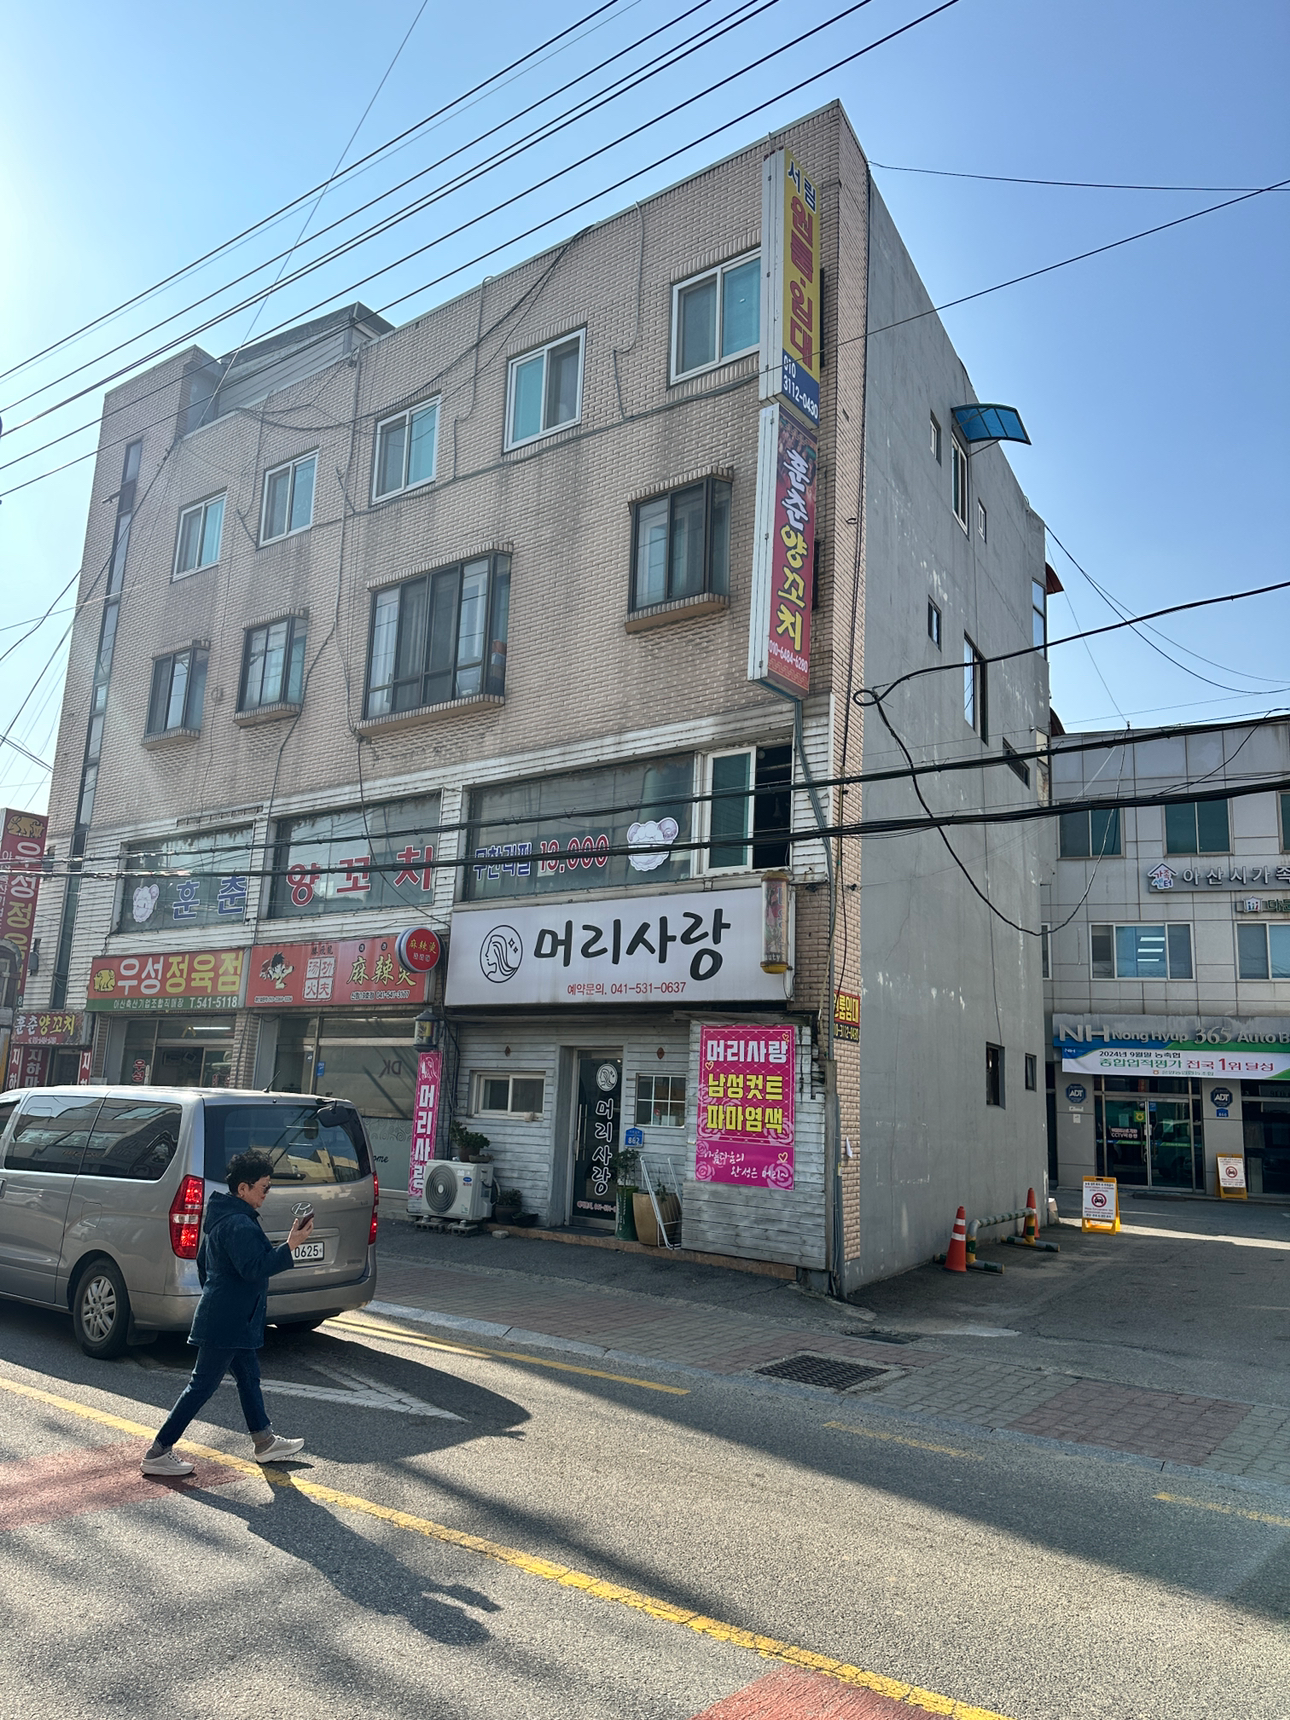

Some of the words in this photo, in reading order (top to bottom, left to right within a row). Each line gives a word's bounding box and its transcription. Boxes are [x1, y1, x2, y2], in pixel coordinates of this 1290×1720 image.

[783, 354, 797, 379] 010
[783, 375, 818, 419] 3112-0430
[1152, 879, 1173, 888] 센터
[1154, 869, 1172, 881] 가족
[533, 908, 731, 981] 머리사랑
[117, 951, 243, 995] 우성정육점
[567, 983, 607, 996] 예약문의.
[610, 981, 687, 995] 041-531-0637
[190, 996, 237, 1009] T.541-5118
[15, 1015, 75, 1036] 훈춘양꼬치
[1059, 1024, 1110, 1042] NH
[1194, 1026, 1232, 1044] 365
[1237, 1031, 1276, 1044] Auto
[706, 1040, 788, 1063] 머리사랑
[1100, 1059, 1182, 1069] 종합업적평가
[1187, 1060, 1214, 1070] 전국
[1218, 1058, 1241, 1071] 1위
[1245, 1062, 1274, 1072] 달성
[708, 1073, 783, 1100] 남성컷트
[1069, 1089, 1083, 1097] ADT
[1214, 1093, 1229, 1101] ADT
[706, 1104, 783, 1134] 파마염색
[592, 1098, 613, 1195] 머리사랑
[294, 1245, 319, 1258] 0625
